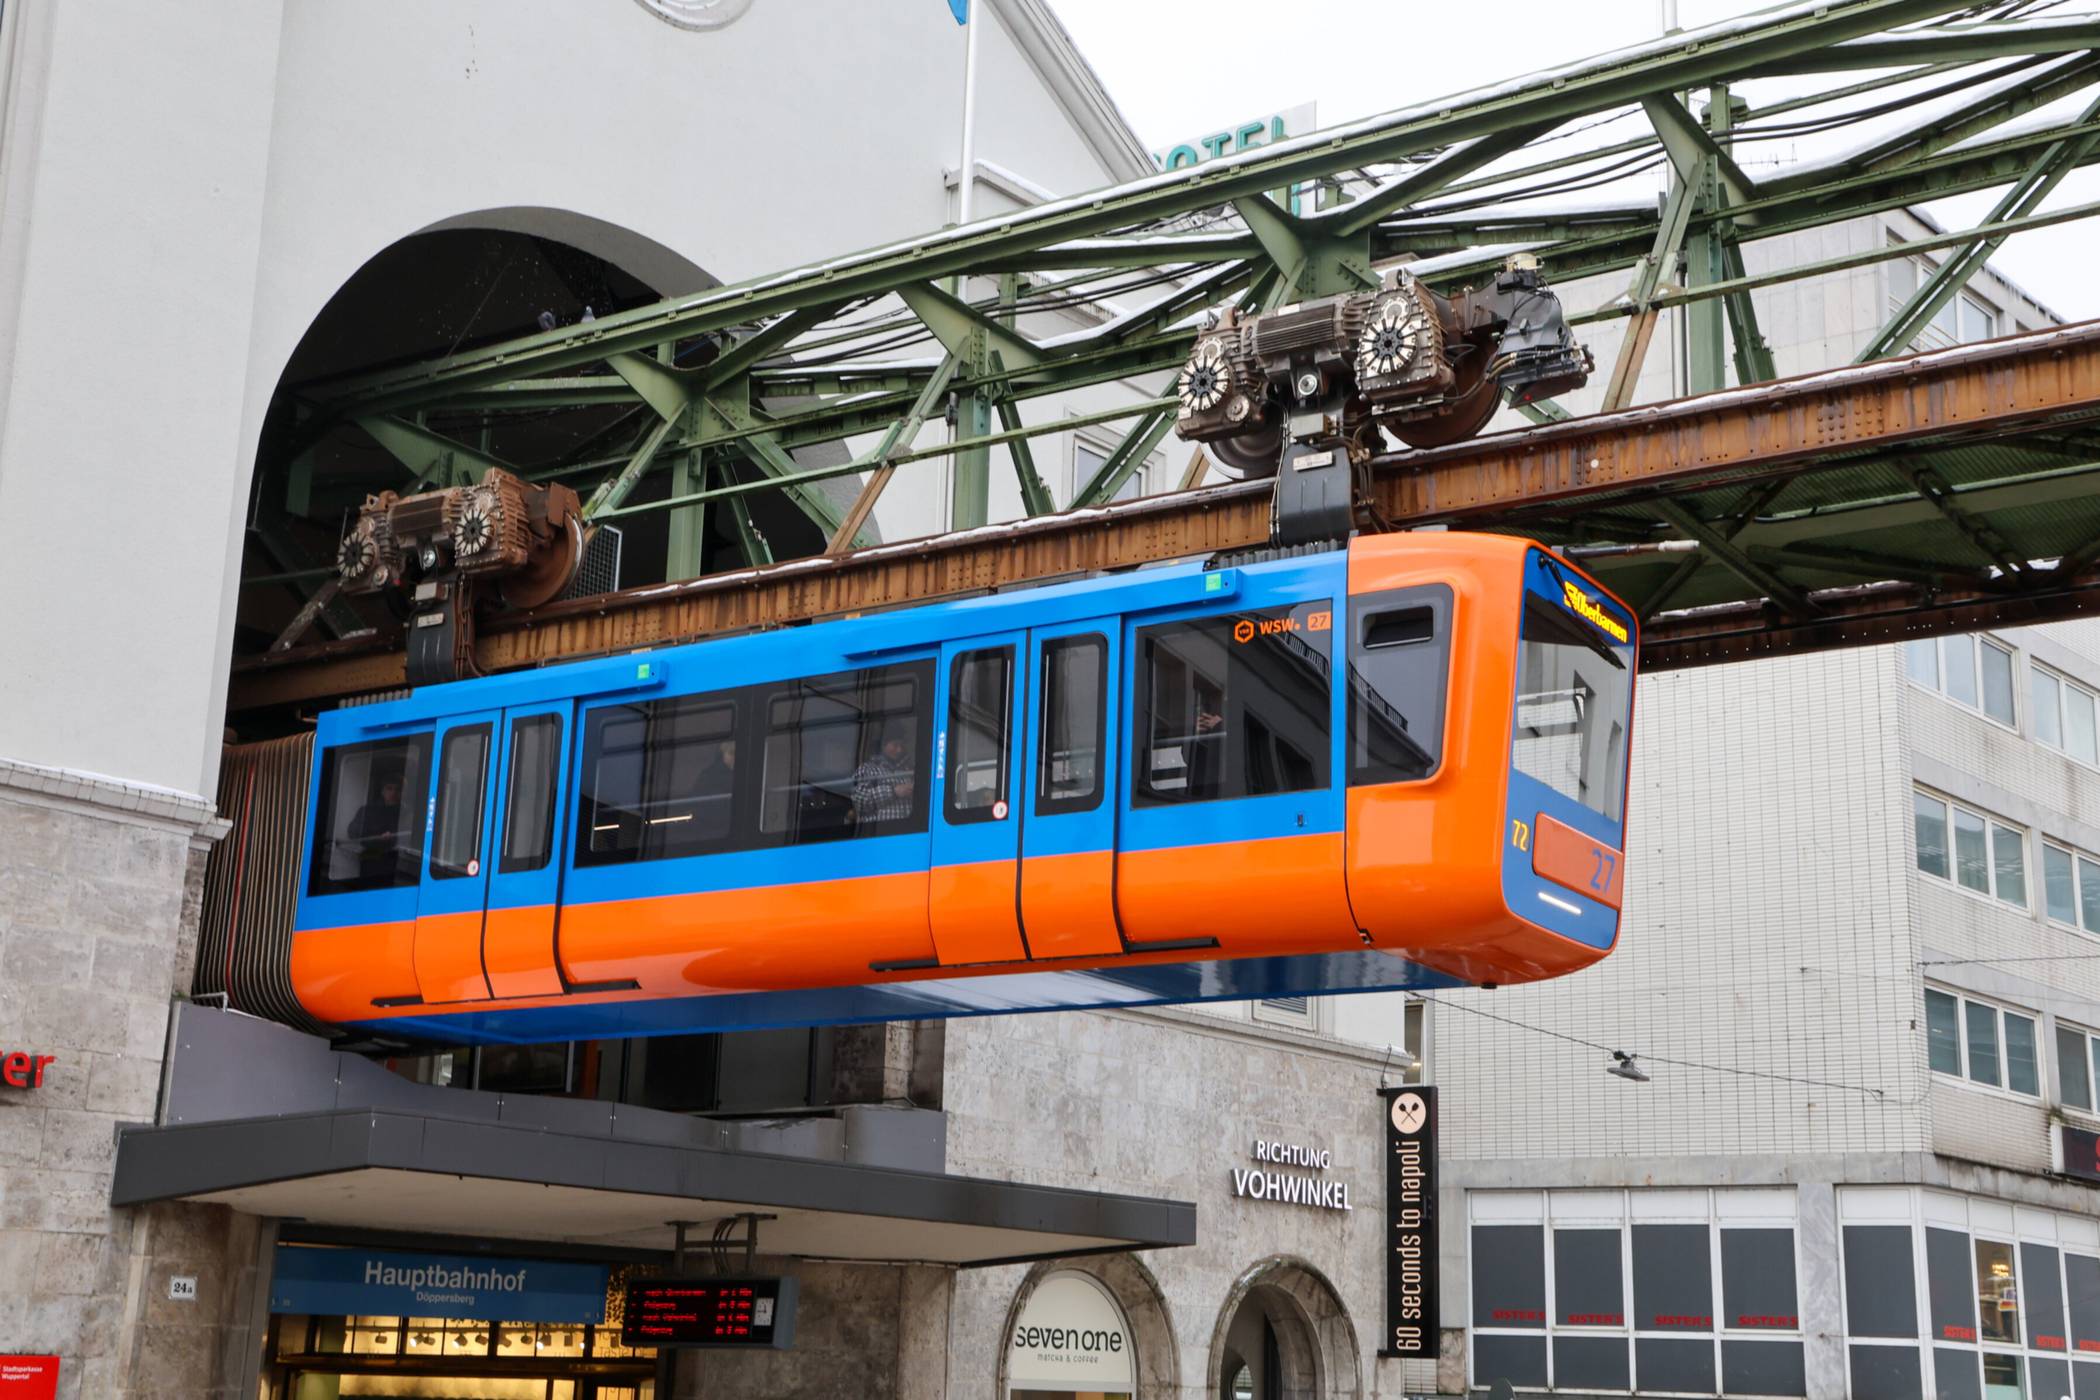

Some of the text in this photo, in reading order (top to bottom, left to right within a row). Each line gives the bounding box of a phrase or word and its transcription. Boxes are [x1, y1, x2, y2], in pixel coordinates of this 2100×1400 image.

[1311, 614, 1327, 628] 27
[1512, 819, 1530, 852] 72
[1590, 848, 1615, 893] 27
[1257, 1140, 1330, 1169] RICHTUNG
[1234, 1168, 1353, 1210] VOHWINKEL
[1395, 1140, 1425, 1351] 60 seconds to napoli
[364, 1260, 526, 1293] Hauptbahnhof
[416, 1291, 475, 1306] Döppersberg
